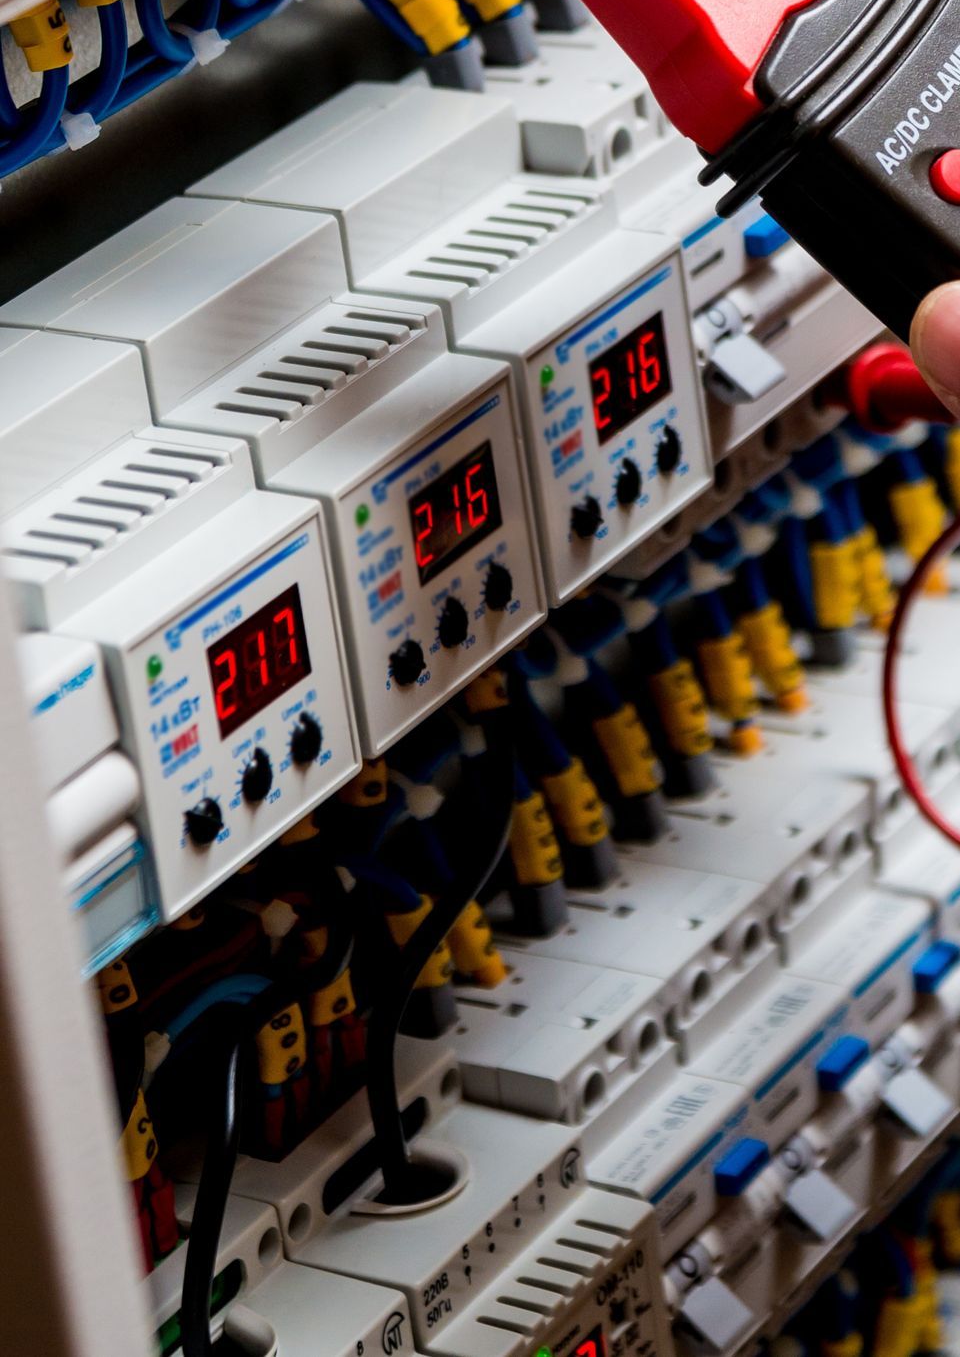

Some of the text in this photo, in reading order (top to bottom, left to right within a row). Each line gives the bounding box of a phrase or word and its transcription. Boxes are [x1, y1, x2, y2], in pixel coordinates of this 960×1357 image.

[875, 106, 931, 176] AC/DC
[591, 330, 662, 431] 216
[413, 462, 489, 568] 216
[213, 606, 298, 721] 217
